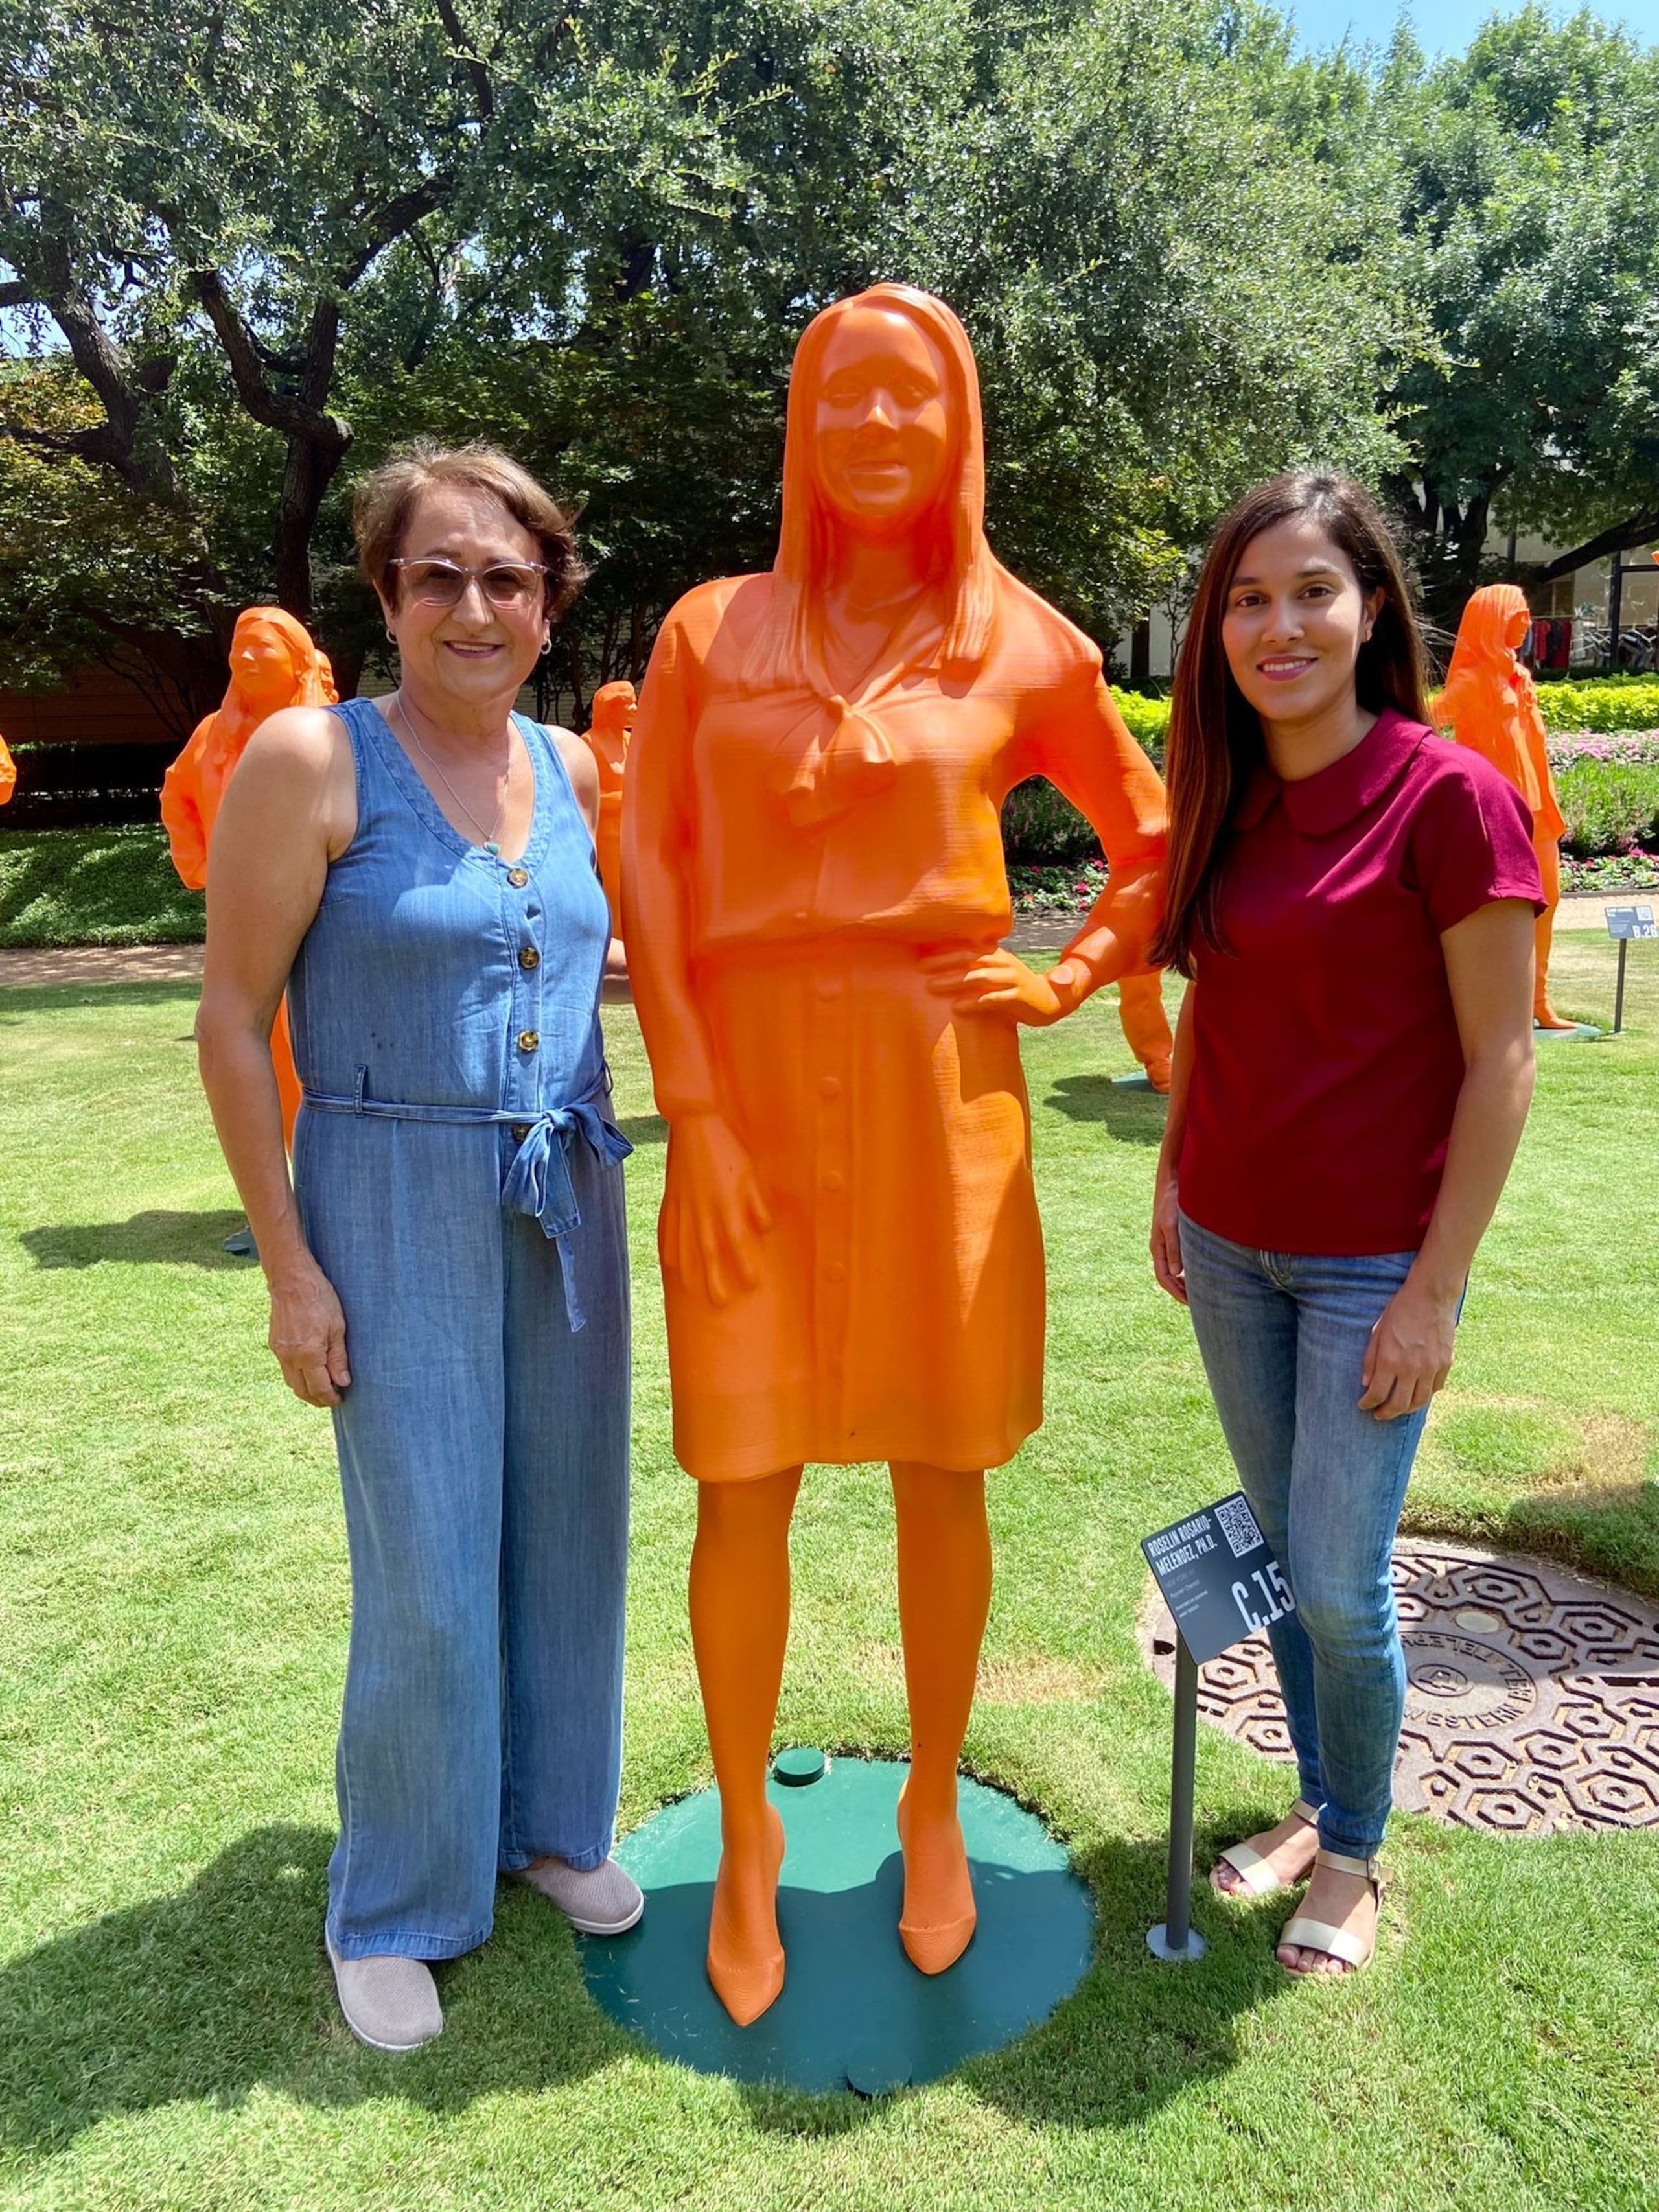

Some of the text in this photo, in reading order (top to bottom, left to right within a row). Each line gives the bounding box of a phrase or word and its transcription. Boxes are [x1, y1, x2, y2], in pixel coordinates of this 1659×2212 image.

[1148, 1515, 1212, 1557] ROSELIN ROSARIO-
[1194, 1534, 1218, 1555] PH.D.
[1231, 1561, 1296, 1633] C.15
